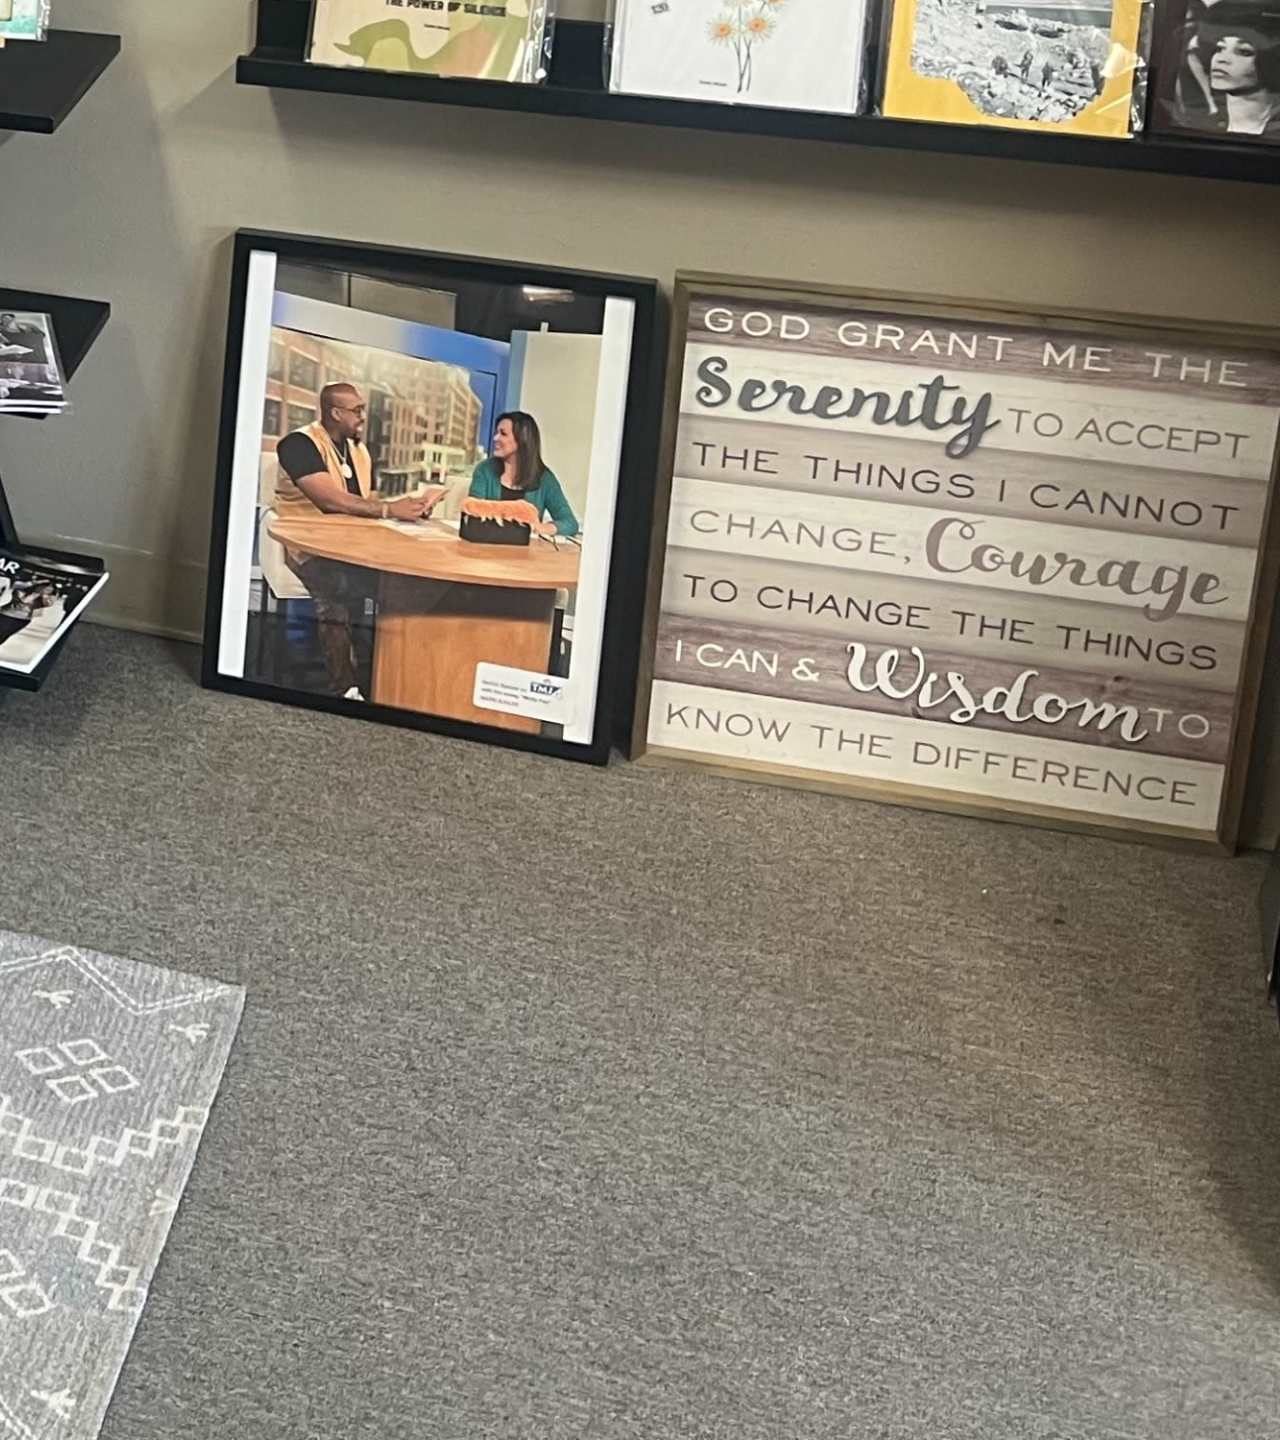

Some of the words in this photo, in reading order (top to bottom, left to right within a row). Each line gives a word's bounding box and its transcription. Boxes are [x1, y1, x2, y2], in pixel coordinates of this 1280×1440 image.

[446, 0, 460, 14] OF
[463, 1, 507, 18] SILENCE
[703, 307, 811, 341] GOD
[836, 320, 1014, 362] GRANT
[1041, 341, 1113, 373] ME
[1144, 350, 1249, 388] THE
[693, 356, 1002, 459] Serenity
[1007, 408, 1065, 439] TO
[1073, 417, 1251, 459] ACCEPT
[691, 441, 779, 475] THE
[803, 454, 977, 500] THINGS
[998, 479, 1007, 503] I
[1029, 483, 1240, 531] CANNOT
[689, 509, 913, 566] CHANGE,
[924, 516, 1230, 621] Courage
[682, 574, 739, 603] TO
[756, 586, 932, 631] CHANGE
[951, 609, 1036, 646] THE
[1057, 625, 1219, 672] THINGS
[675, 639, 683, 663] I
[695, 643, 779, 678] CAN
[791, 656, 821, 683] &
[844, 640, 1150, 744] Wisdom
[1150, 707, 1212, 740] TO
[665, 702, 792, 745] KNOW
[810, 724, 894, 760] THE
[911, 741, 1198, 808] DIFFERENCE
